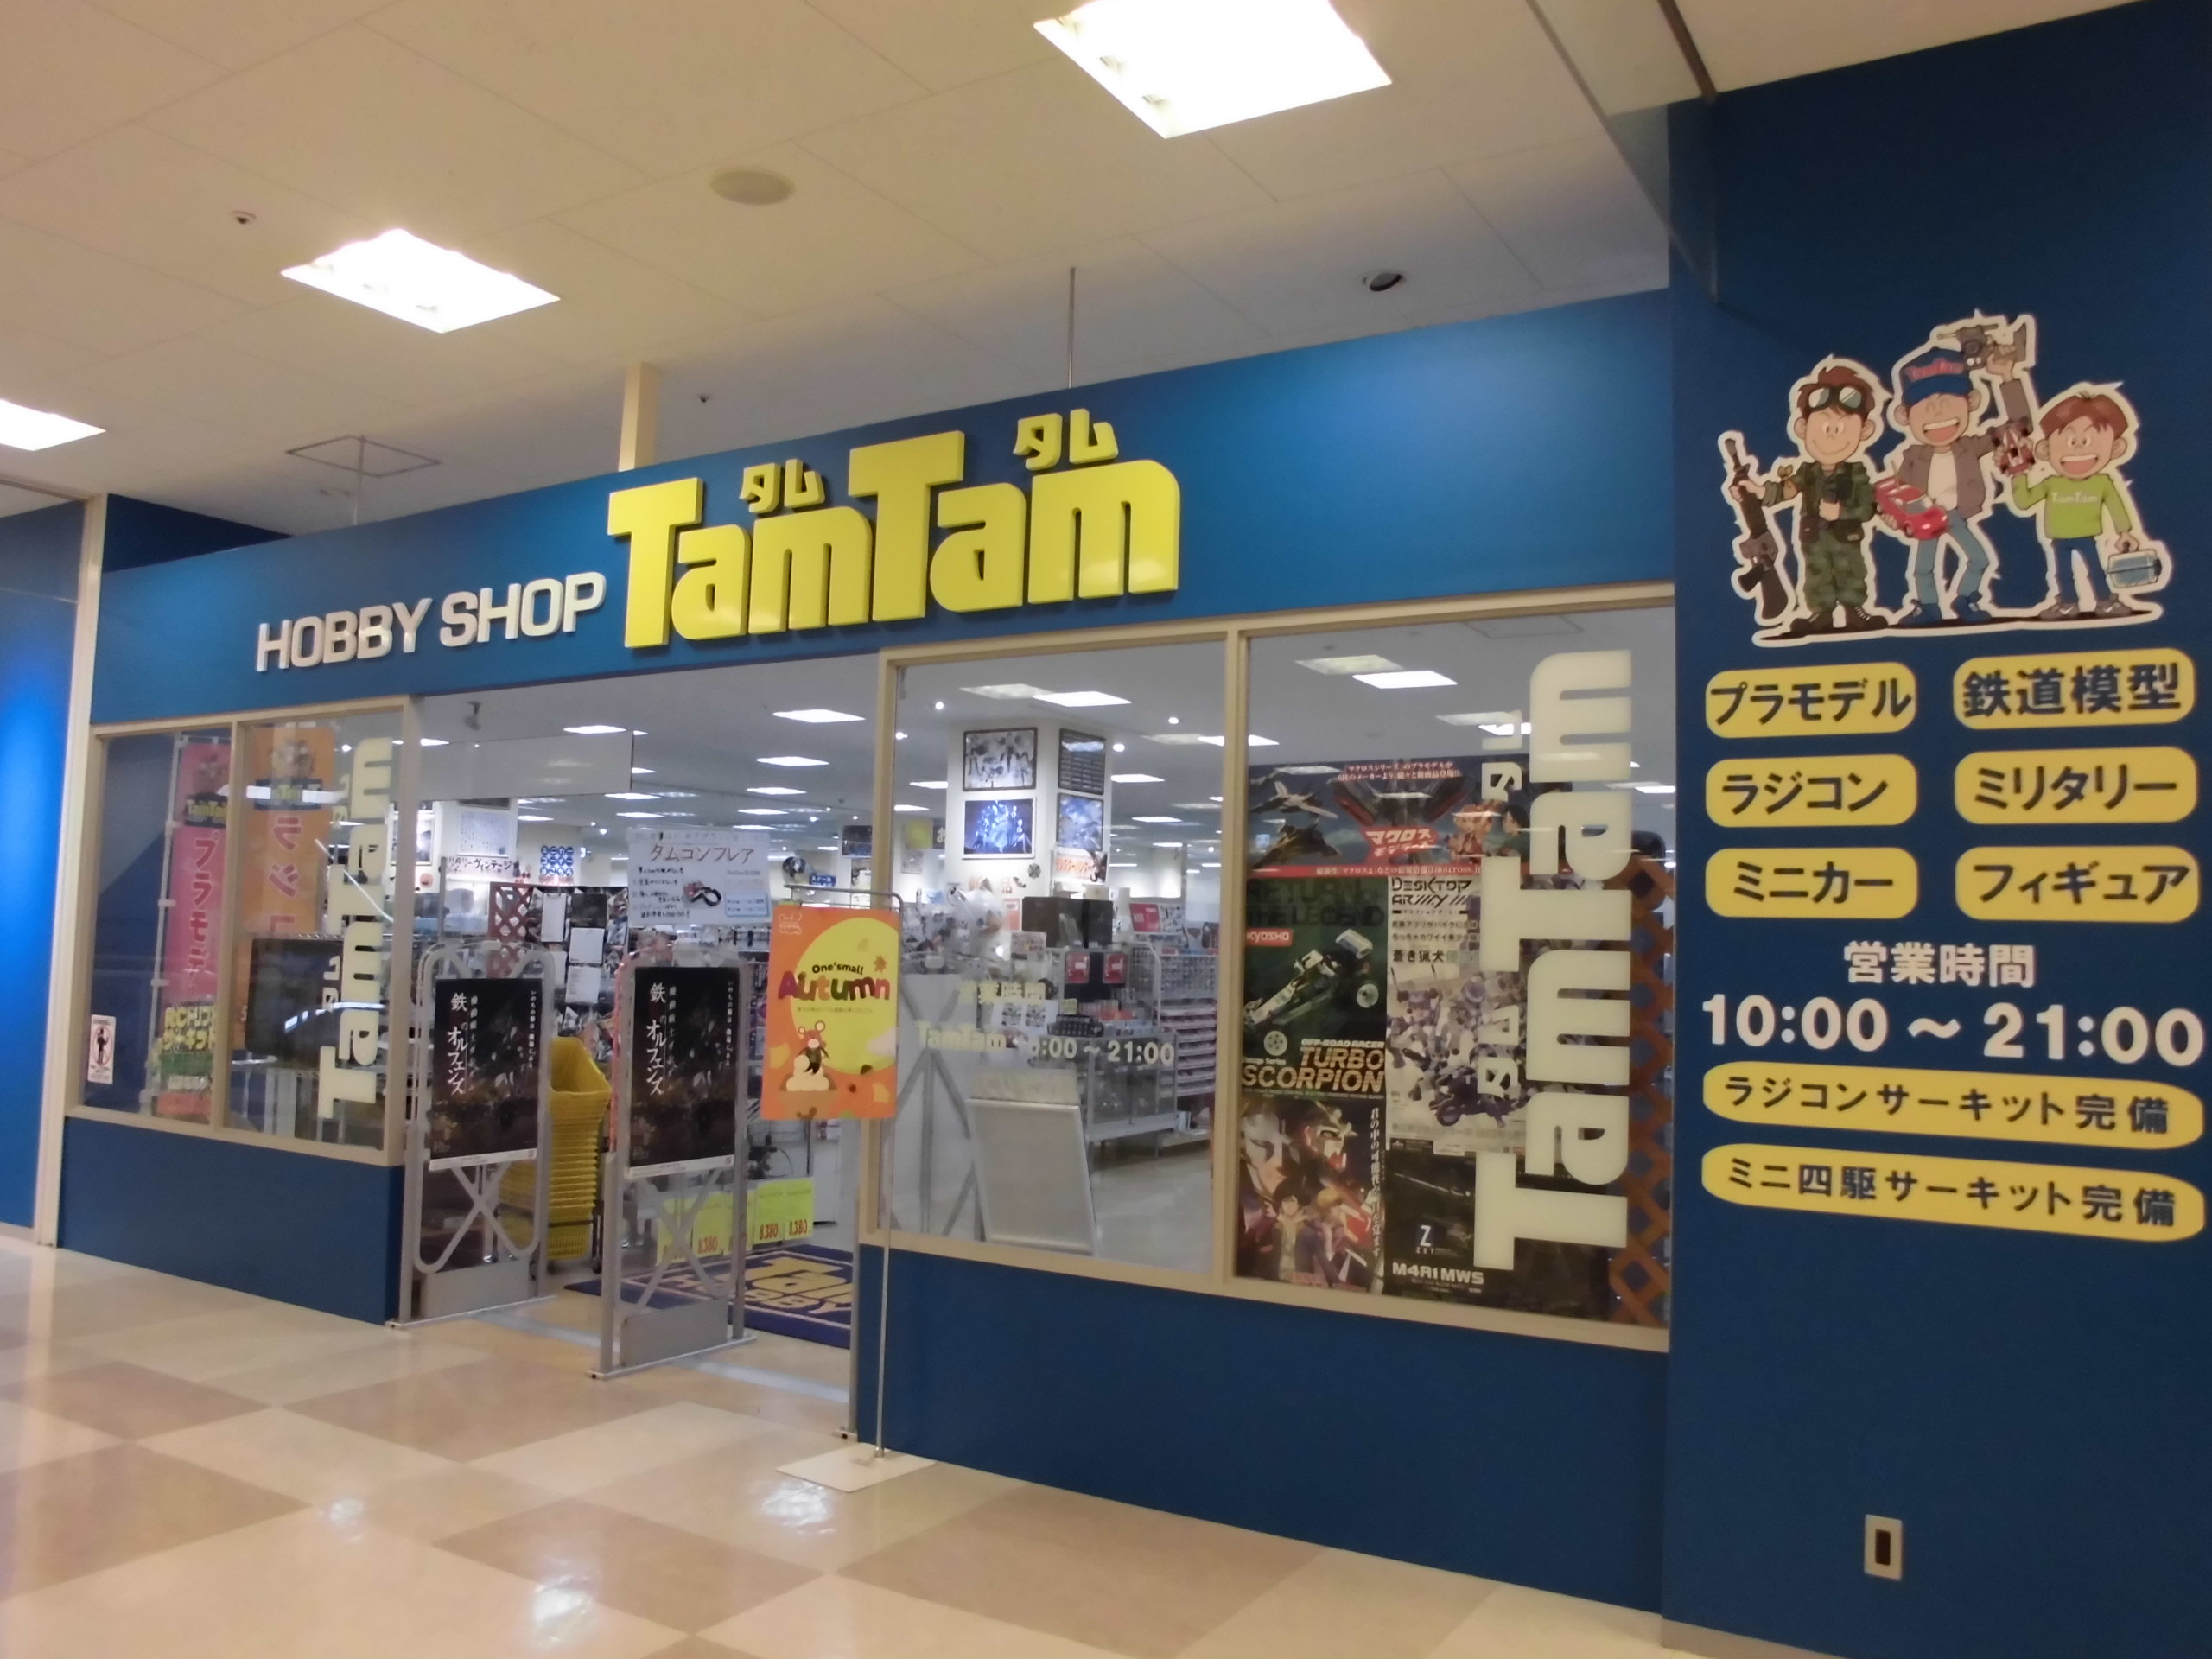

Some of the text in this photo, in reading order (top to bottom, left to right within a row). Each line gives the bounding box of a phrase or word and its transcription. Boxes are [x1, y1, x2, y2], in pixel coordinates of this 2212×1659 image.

[257, 430, 1180, 671] HOBBY SHOP TamTam
[1710, 677, 1913, 726] プラモデル
[1962, 663, 2182, 718] 鉄道模型
[1722, 772, 1888, 815] ラジコン
[1974, 764, 2177, 811] ミリタリー
[1365, 829, 1433, 845] マクロス
[1391, 876, 1473, 893] DESKTOP
[1733, 861, 1894, 904] ミニカー
[1973, 860, 2190, 905] フィギュア
[1246, 931, 1290, 944] KYOSHO
[1473, 650, 1632, 1271] TamTam
[1843, 940, 2036, 988] 営業時間
[778, 970, 891, 1001] Autumn
[1106, 1039, 1176, 1065] 21:00
[1351, 1040, 1385, 1049] RACER
[1702, 994, 1889, 1052] 10:00
[1983, 1002, 2205, 1068] 21:00
[1243, 1065, 1385, 1093] SCORPION
[1300, 1046, 1385, 1071] TURBO
[1724, 1076, 2169, 1135] ラジコンサーキット完備
[1728, 1157, 2176, 1227] ミニ四駆サーキット完備
[1440, 1268, 1484, 1285] MWS
